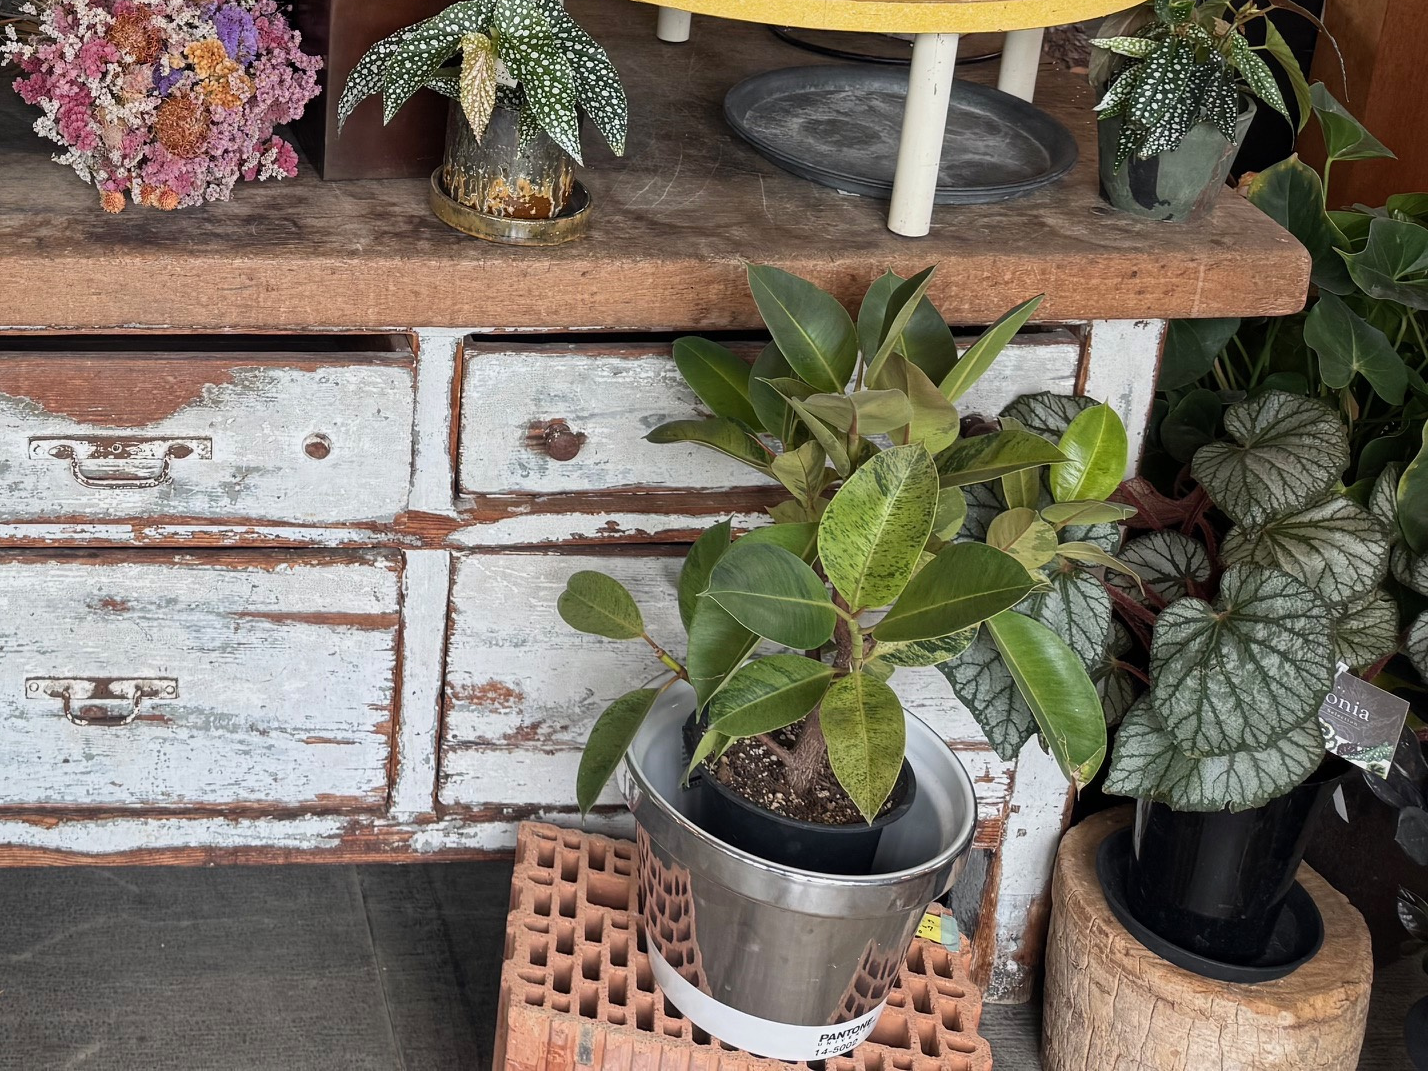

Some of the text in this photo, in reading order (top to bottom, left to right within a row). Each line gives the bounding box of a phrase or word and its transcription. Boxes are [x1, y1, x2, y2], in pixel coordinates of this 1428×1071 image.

[1325, 692, 1370, 722] onia
[819, 1016, 876, 1043] PANTONE
[814, 1038, 859, 1057] 14-5002
